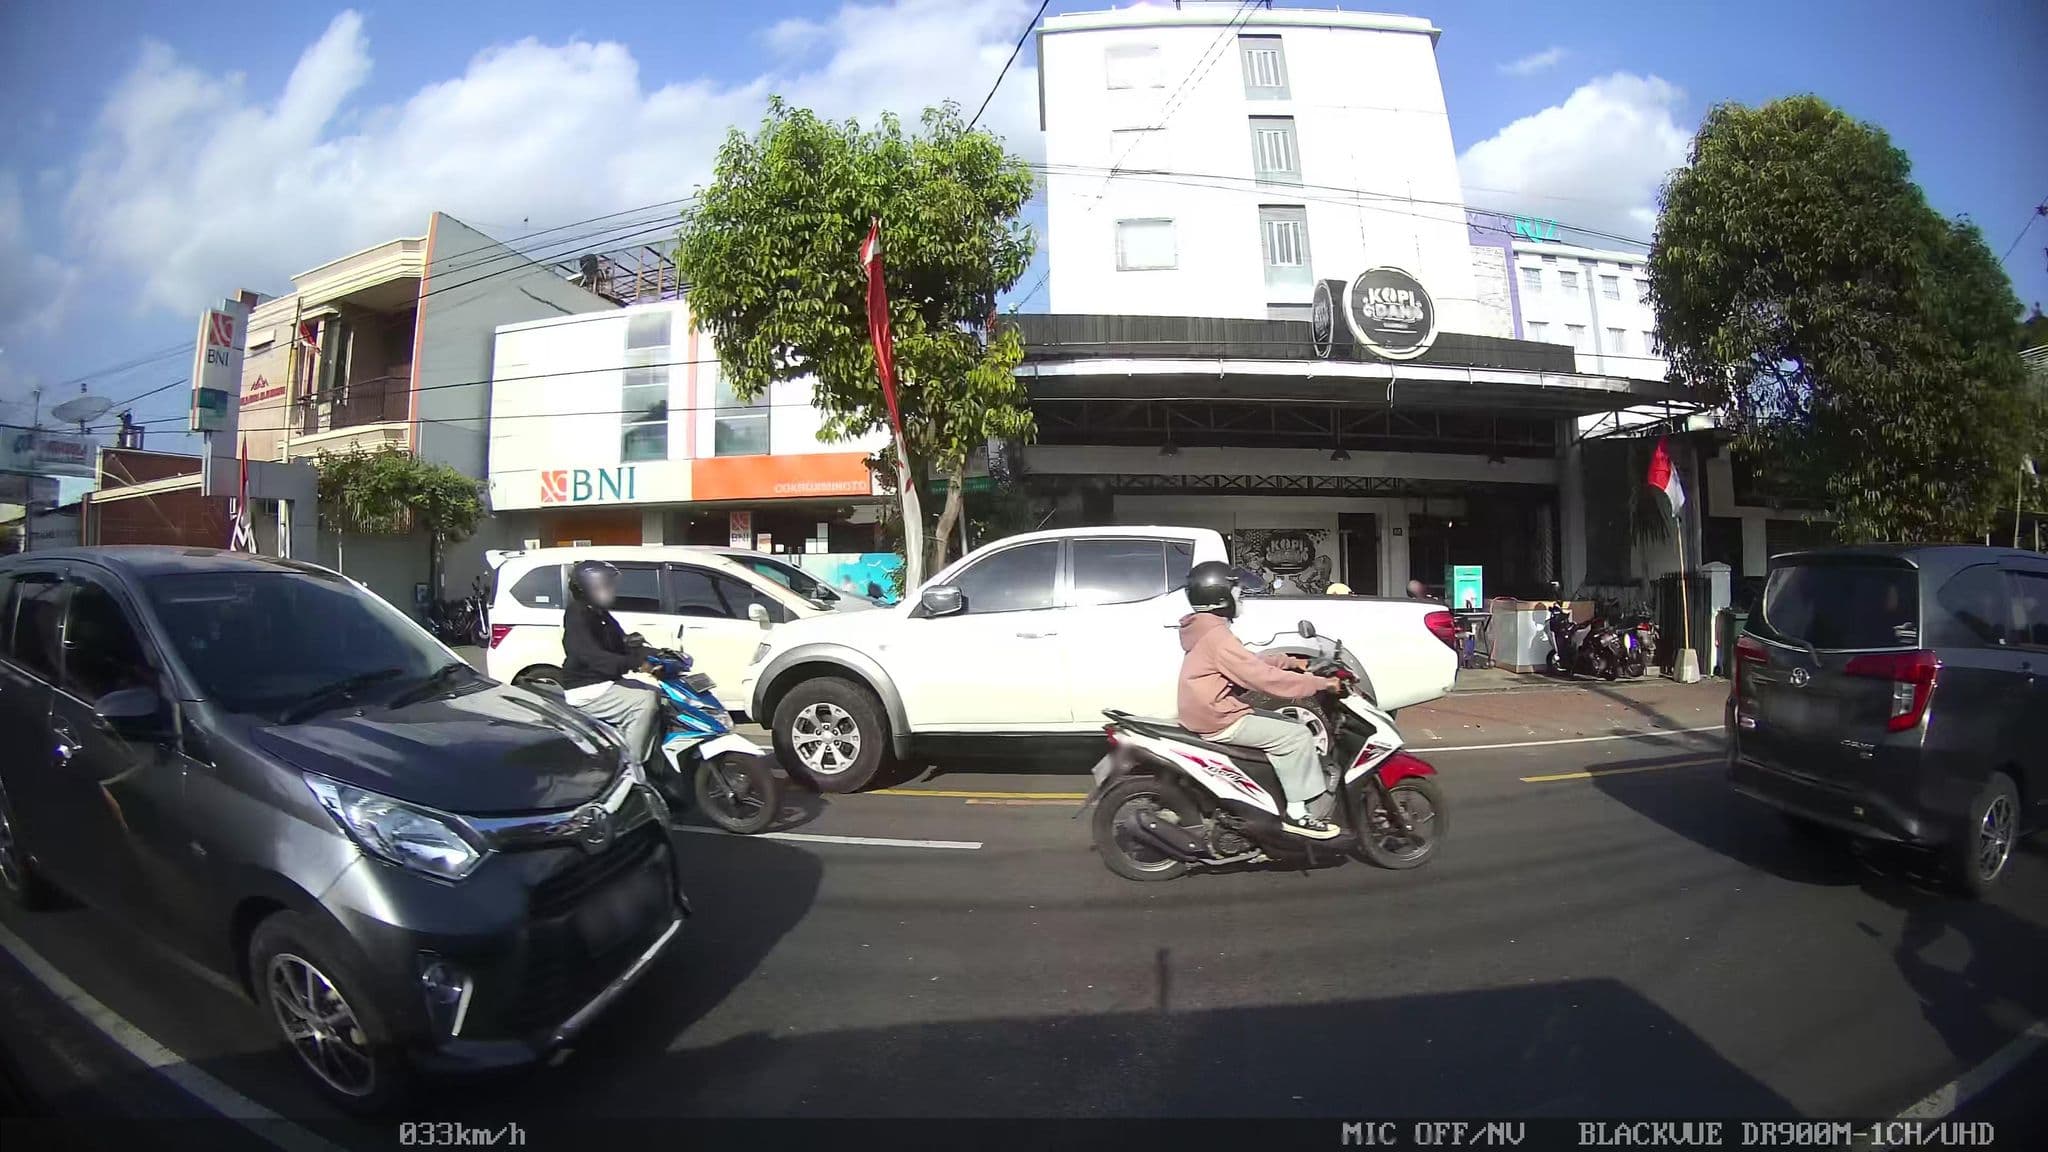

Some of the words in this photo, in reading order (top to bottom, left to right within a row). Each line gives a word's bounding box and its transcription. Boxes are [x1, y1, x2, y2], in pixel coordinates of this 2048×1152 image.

[1368, 287, 1415, 306] KOPI
[207, 349, 229, 367] BNI
[573, 466, 636, 501] BNI
[731, 533, 750, 542] BNI
[1270, 539, 1304, 552] KOPI
